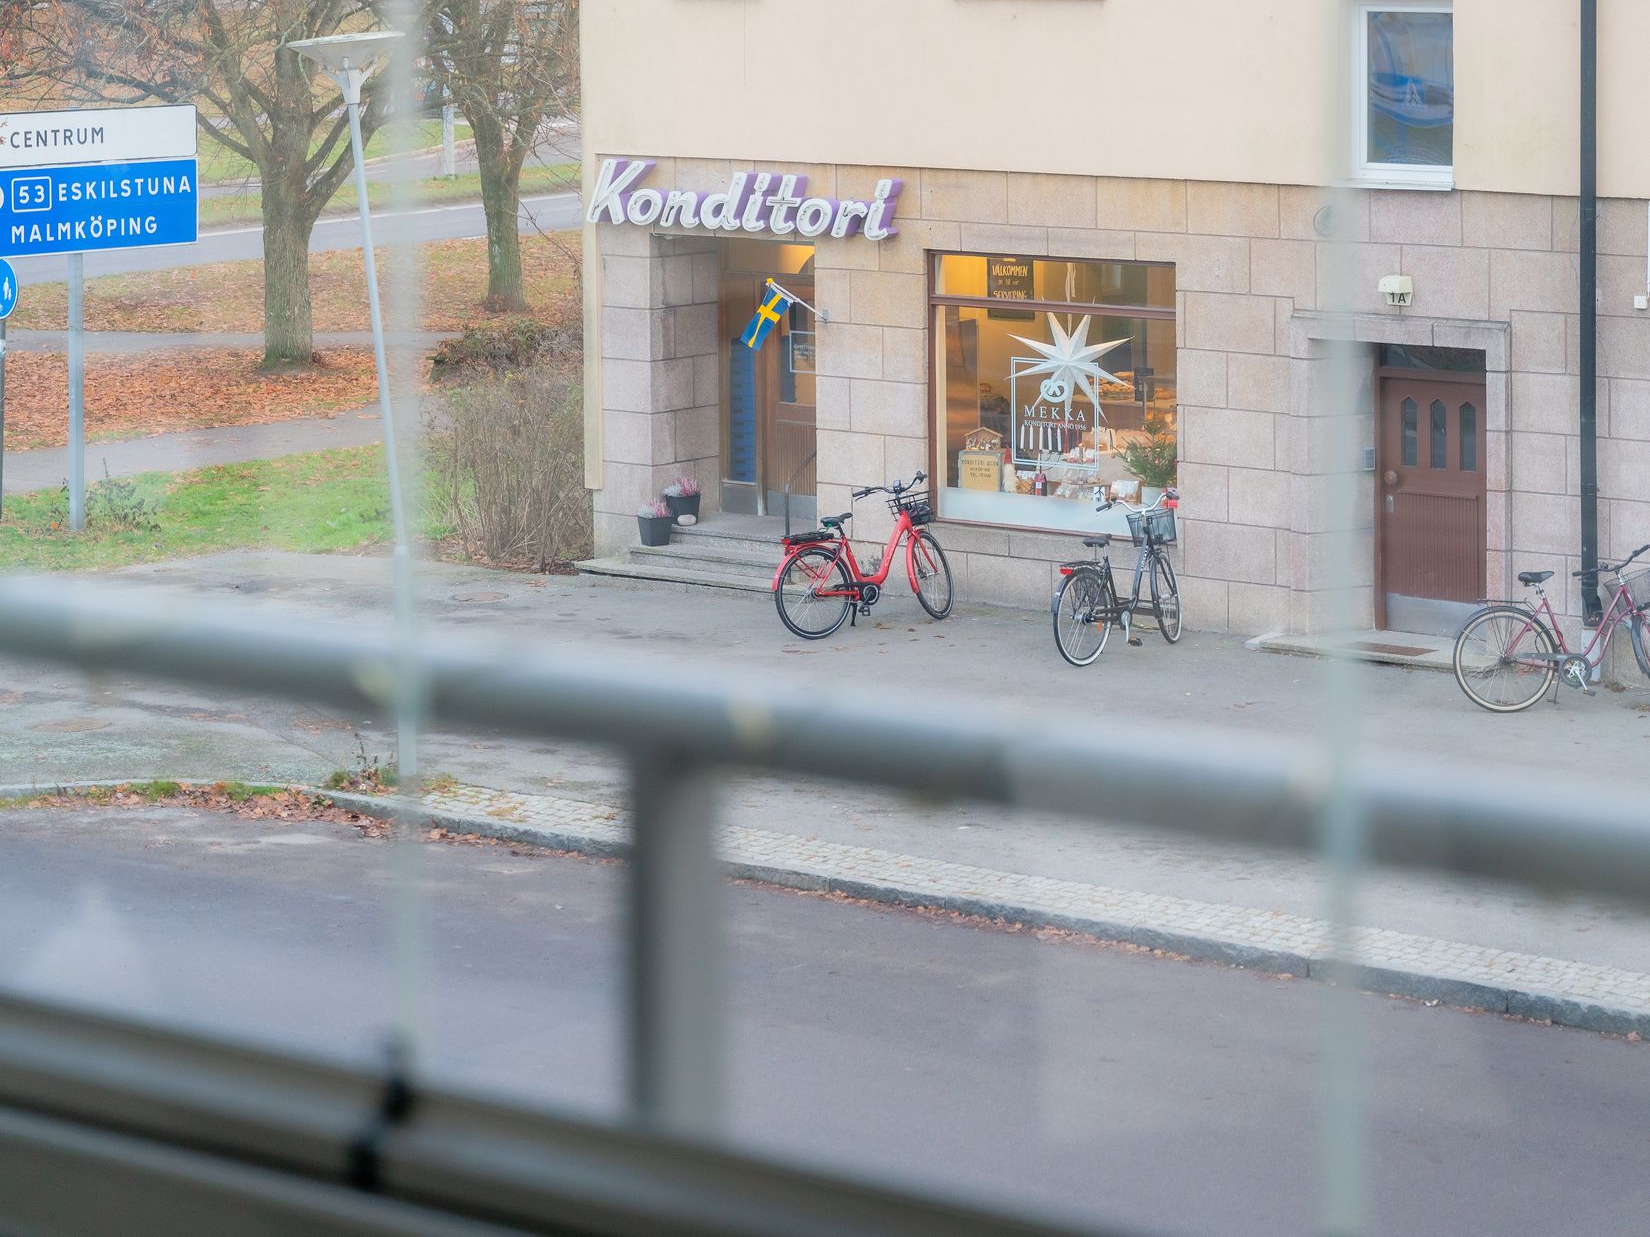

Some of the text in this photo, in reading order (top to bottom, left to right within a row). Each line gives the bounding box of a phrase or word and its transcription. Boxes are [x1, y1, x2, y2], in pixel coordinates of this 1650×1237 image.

[10, 126, 104, 149] CENTRUM
[18, 175, 191, 204] 53 ESKILSTUNA
[586, 158, 903, 241] Konditori
[11, 215, 158, 244] MALMKÖPING
[1023, 404, 1086, 422] MEKKA
